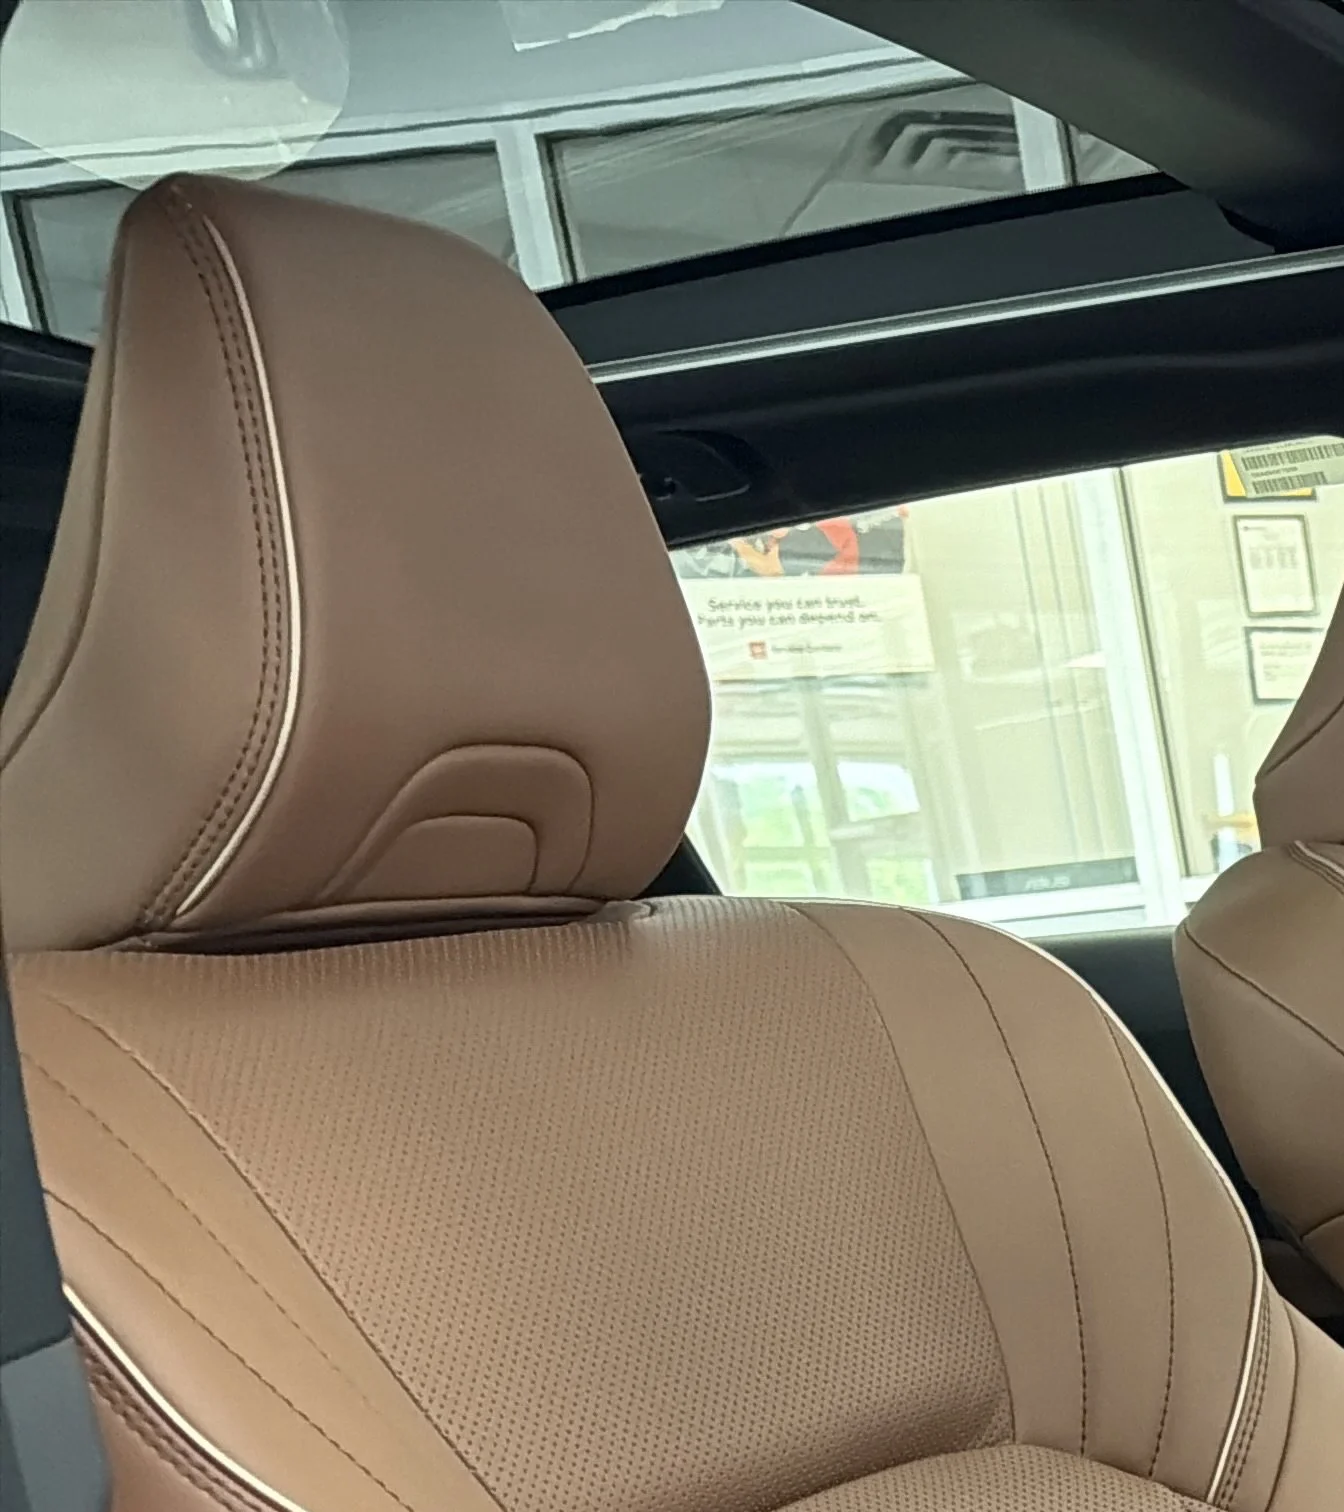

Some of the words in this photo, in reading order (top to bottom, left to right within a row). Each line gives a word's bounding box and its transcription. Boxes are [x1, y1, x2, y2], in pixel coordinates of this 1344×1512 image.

[707, 598, 761, 612] Service
[767, 600, 793, 612] you
[797, 598, 822, 609] can
[739, 614, 766, 630] you
[769, 613, 796, 626] can
[799, 611, 855, 625] depend
